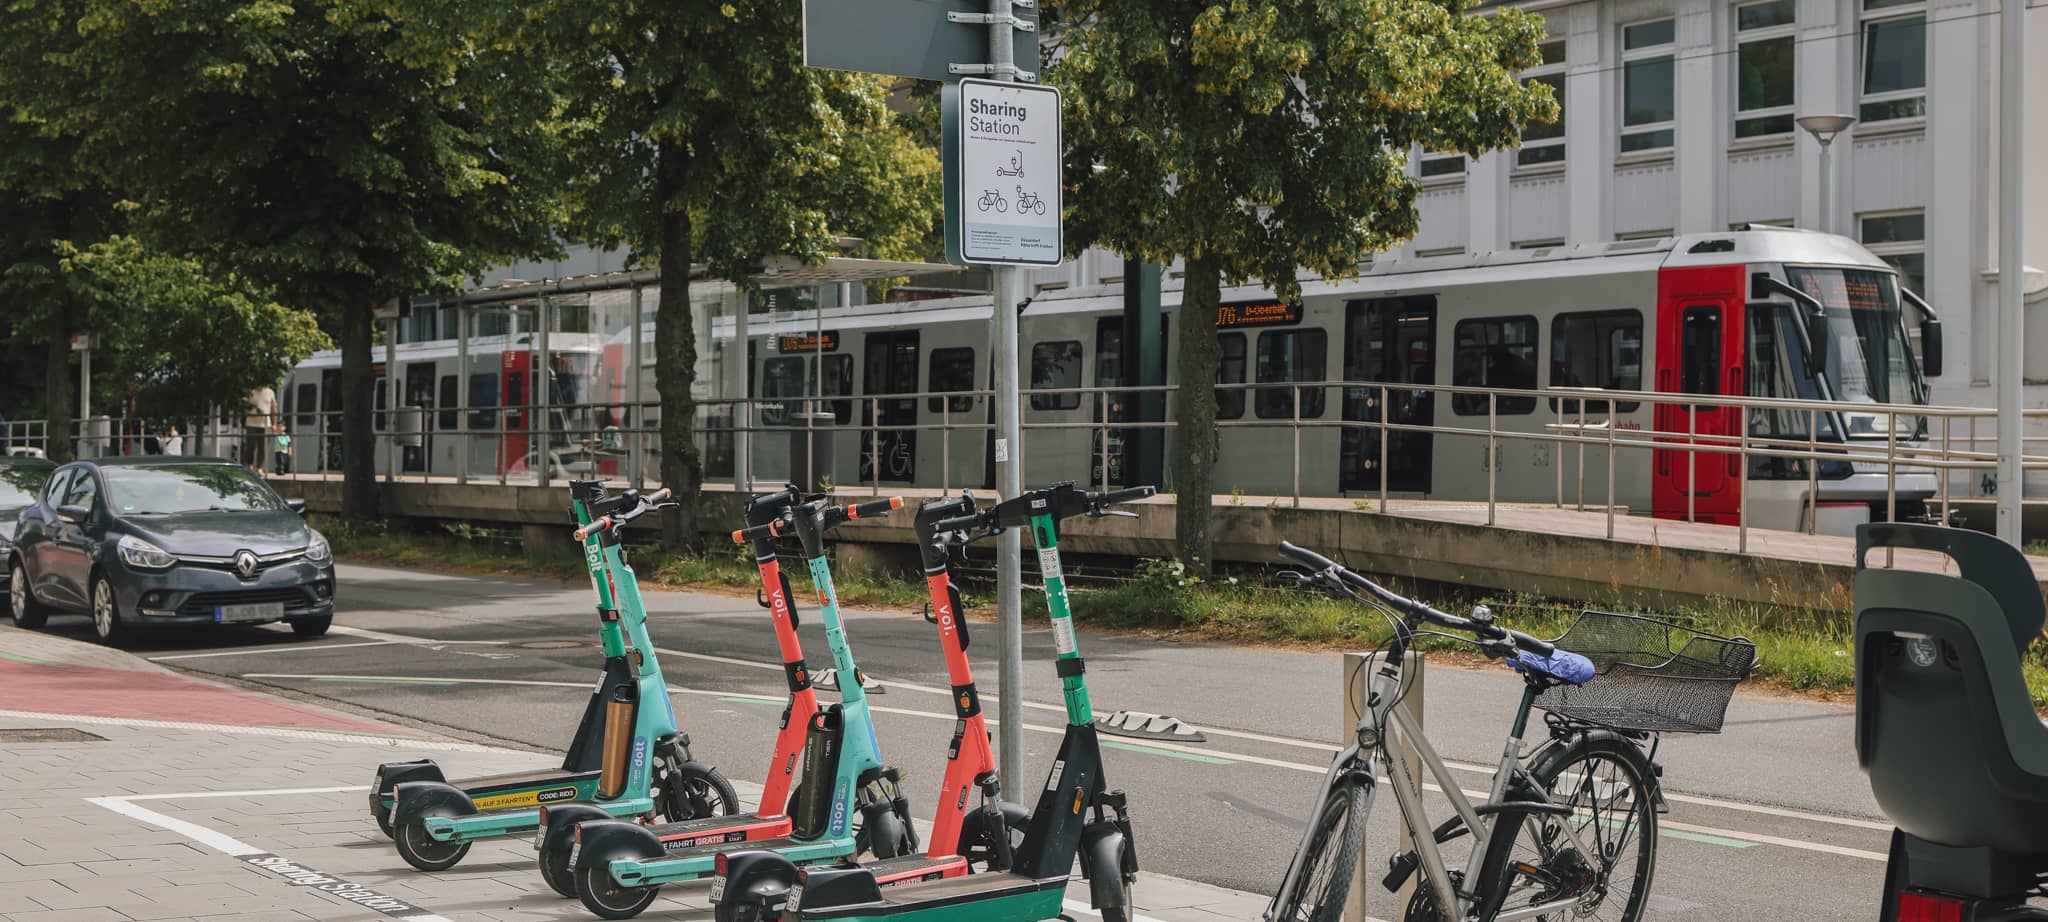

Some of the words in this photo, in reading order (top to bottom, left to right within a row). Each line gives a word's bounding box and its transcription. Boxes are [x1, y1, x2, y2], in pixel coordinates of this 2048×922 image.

[970, 98, 1026, 121] Sharing
[970, 116, 1020, 135] Station
[587, 544, 602, 572] Bolt
[772, 588, 788, 618] voi.
[939, 604, 956, 636] voi.
[634, 741, 645, 767] dott
[832, 802, 845, 831] dott
[668, 839, 694, 850] FAHRT
[695, 835, 725, 846] GRATIS
[248, 857, 338, 885] Sharing
[318, 883, 410, 912] Station
